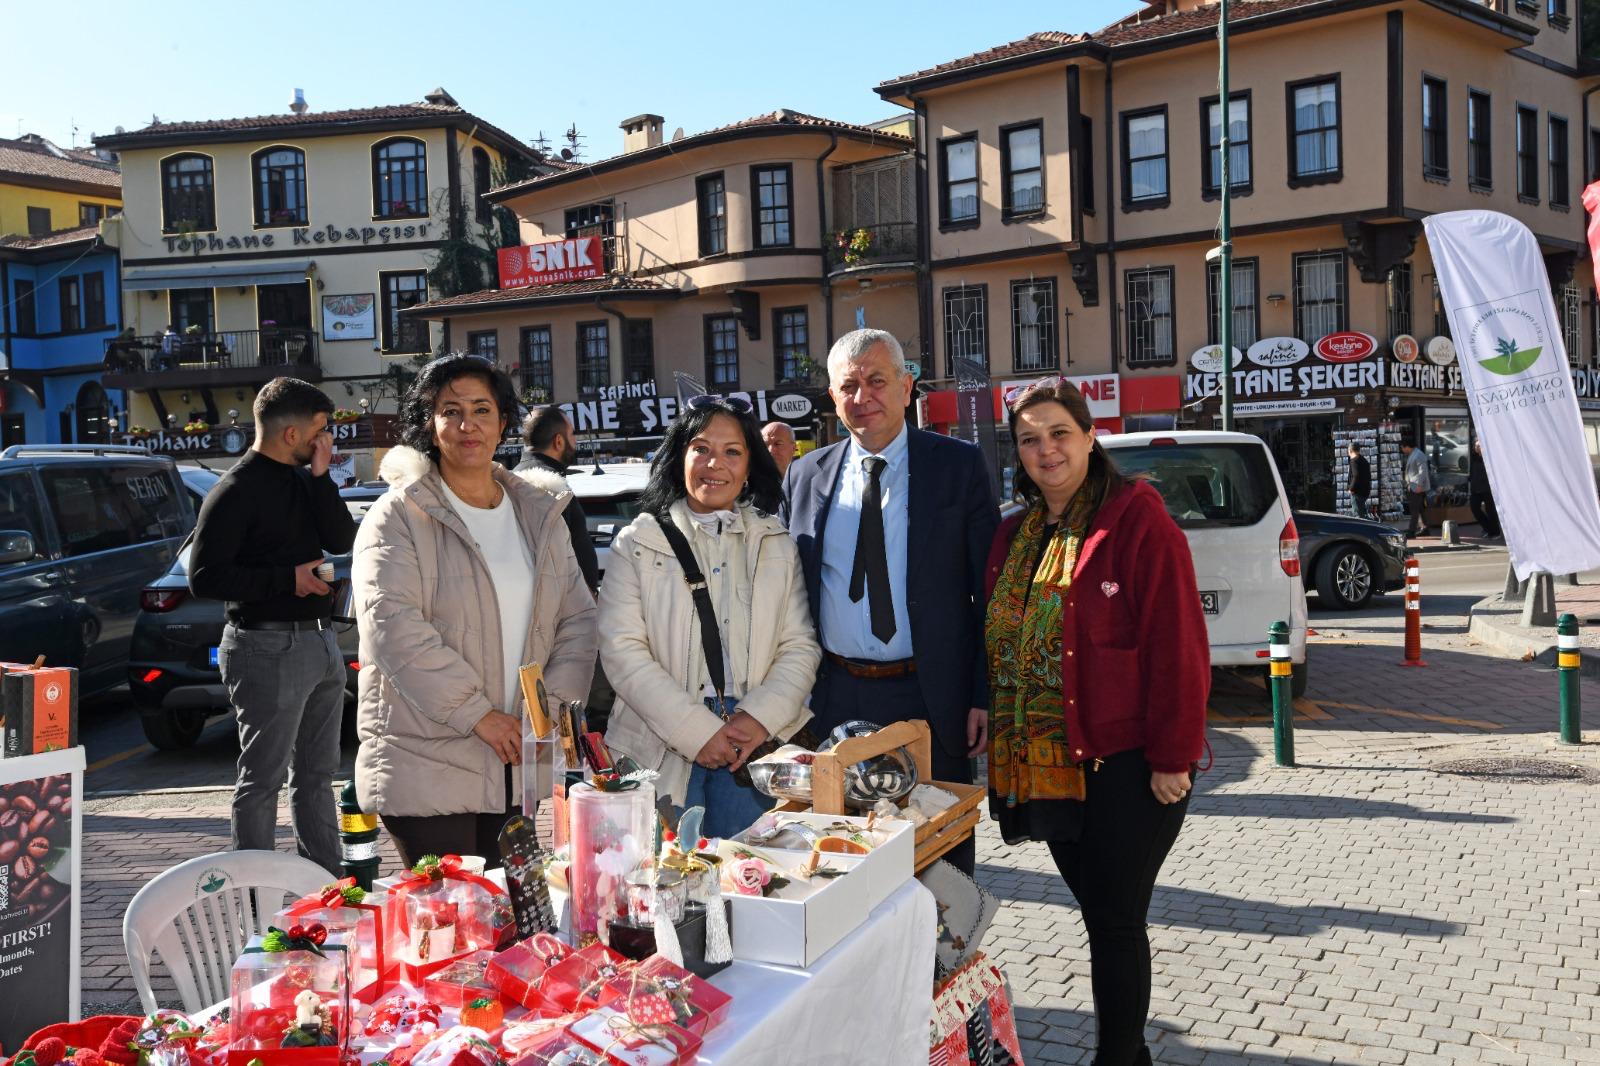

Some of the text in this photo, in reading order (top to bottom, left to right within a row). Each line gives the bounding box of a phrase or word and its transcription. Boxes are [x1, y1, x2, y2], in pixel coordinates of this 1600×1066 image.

[162, 233, 274, 256] Tophane
[529, 239, 593, 272] 5N1K
[504, 269, 597, 286] www.bursa5n1k.com
[1298, 357, 1385, 397] ŞEKERİ
[1391, 361, 1445, 391] KESTANE
[776, 400, 807, 413] MARKET
[2, 921, 52, 949] FIRST!
